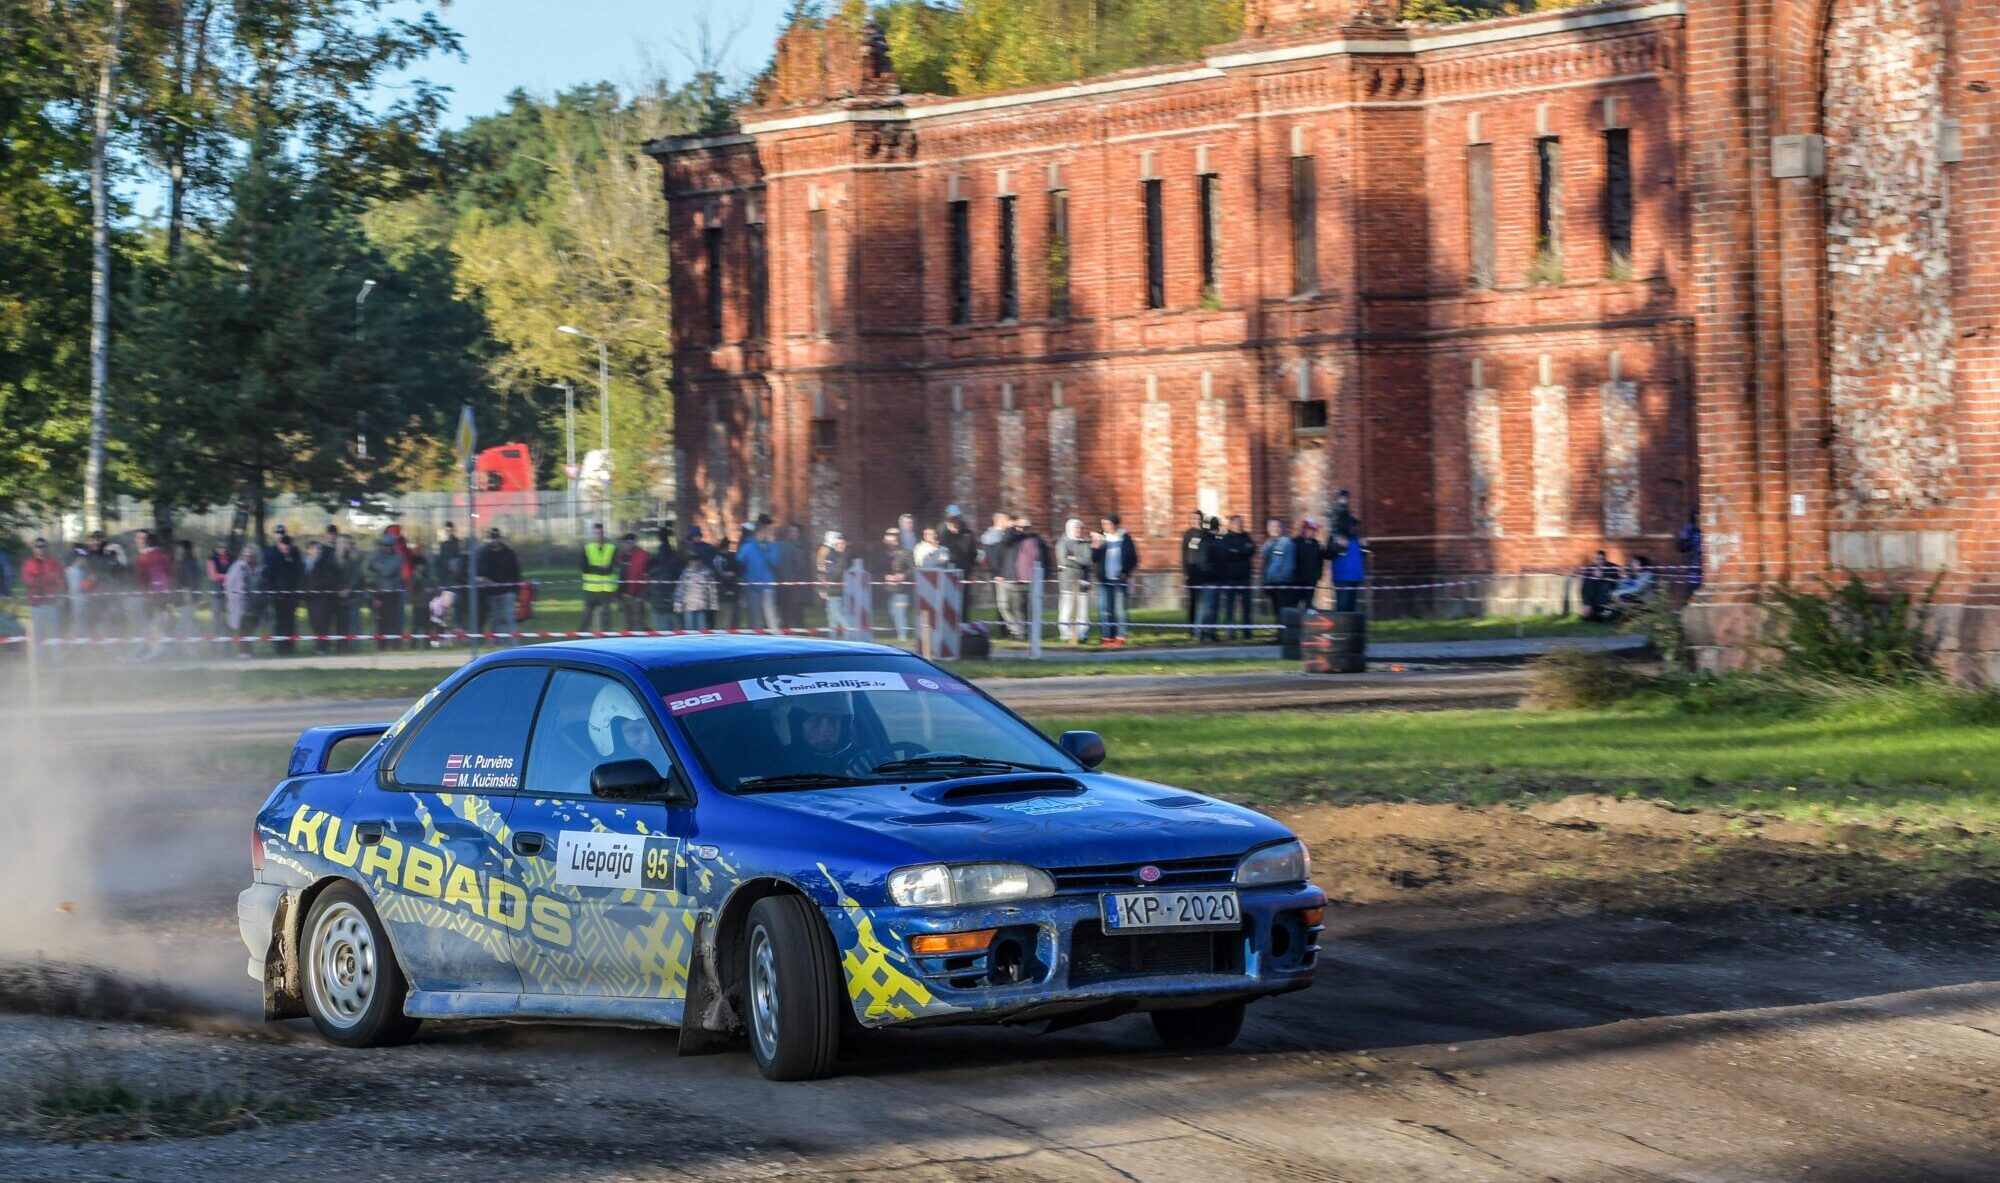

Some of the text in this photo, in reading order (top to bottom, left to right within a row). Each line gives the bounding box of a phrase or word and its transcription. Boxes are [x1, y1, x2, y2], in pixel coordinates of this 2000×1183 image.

[670, 692, 722, 710] 2021
[462, 755, 513, 769] K. Purvēns
[458, 773, 518, 787] M. Kučinskis
[571, 842, 669, 880] Liepāja 95
[287, 803, 572, 947] KURBADS
